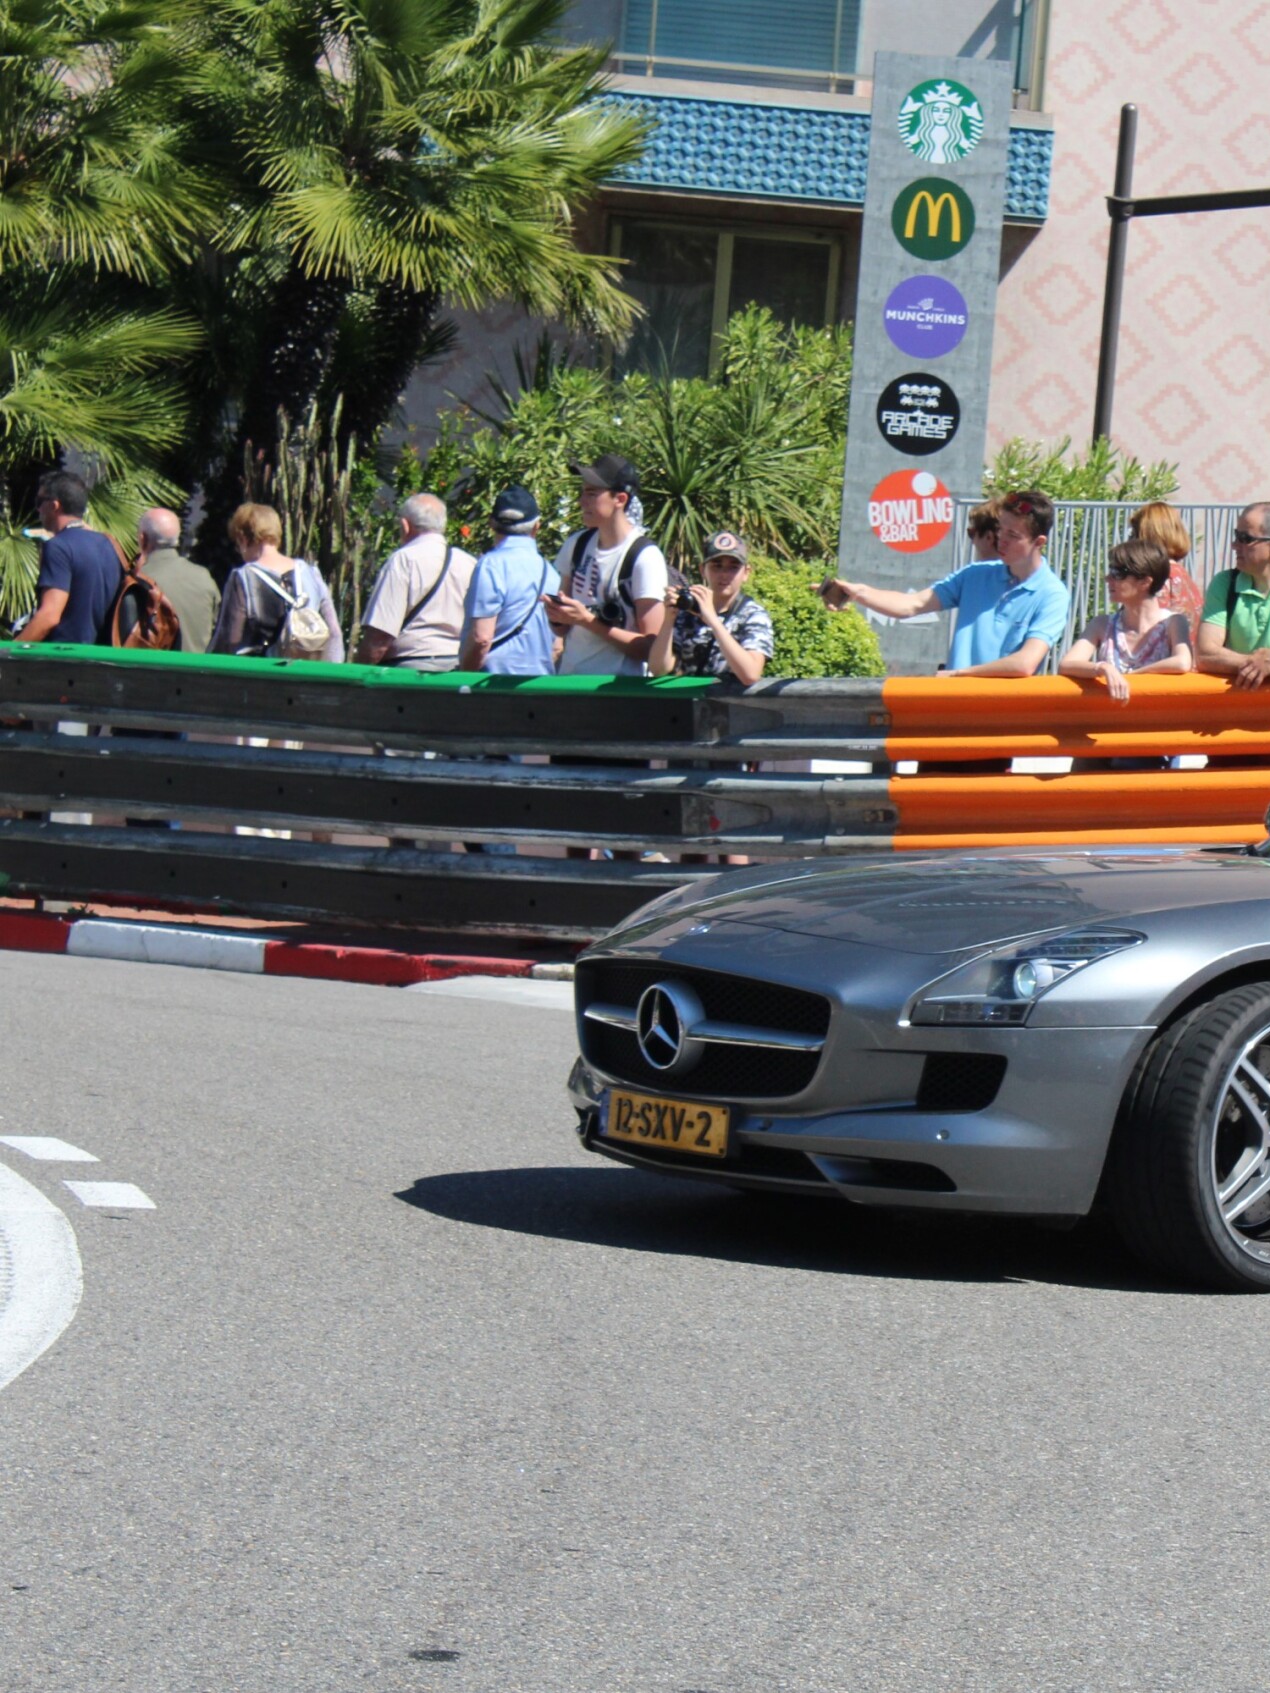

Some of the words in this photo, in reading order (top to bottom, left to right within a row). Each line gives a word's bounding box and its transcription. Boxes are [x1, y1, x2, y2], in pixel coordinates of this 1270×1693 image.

[886, 310, 966, 325] MUNCHKINS
[882, 411, 954, 429] ARCADE
[887, 422, 947, 439] GAMES
[868, 497, 954, 527] BOWLING
[615, 1097, 713, 1147] 12-SXV-2
